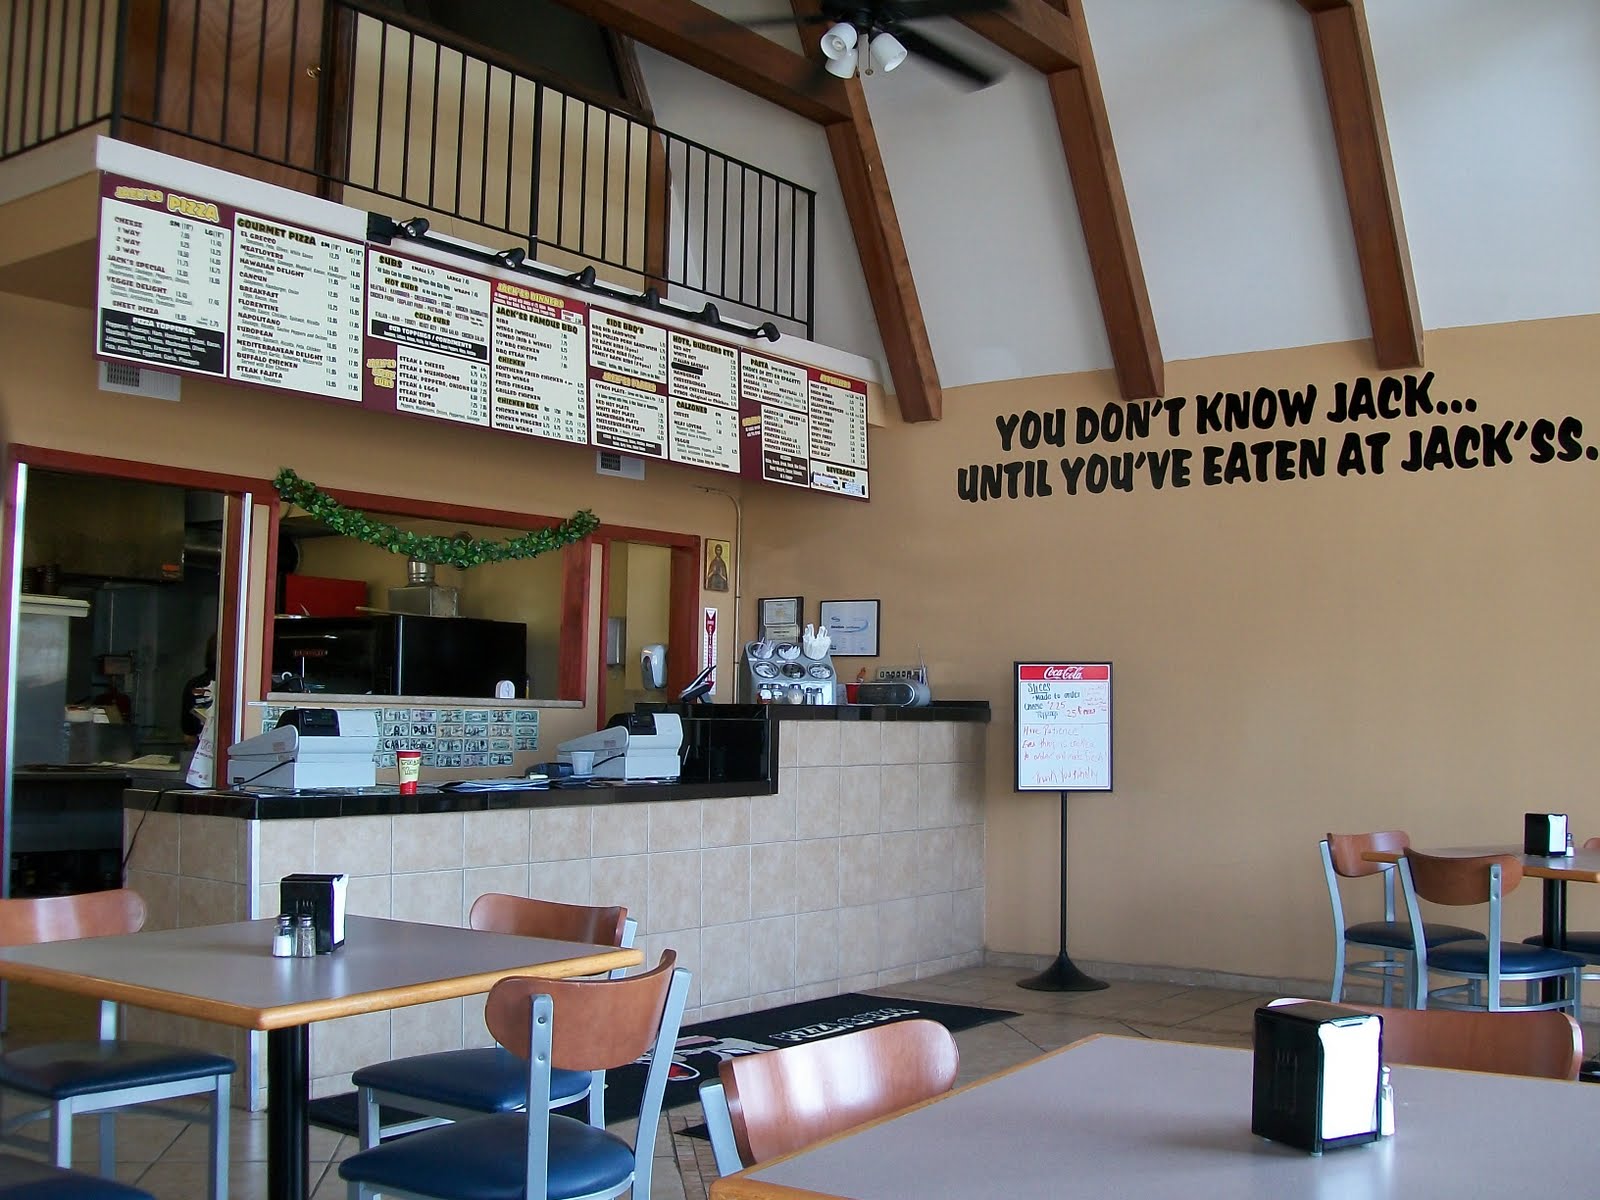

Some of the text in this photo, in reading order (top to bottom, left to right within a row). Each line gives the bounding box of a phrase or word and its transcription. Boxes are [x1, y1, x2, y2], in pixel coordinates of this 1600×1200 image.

[167, 194, 219, 224] PIZZA
[115, 217, 142, 229] CHEESE
[123, 228, 140, 237] WAY
[238, 218, 286, 239] GOURMET
[289, 231, 316, 246] PIZZA
[123, 238, 140, 247] WAY
[123, 247, 140, 256] WAY
[241, 245, 283, 260] MEATLOVERS
[107, 254, 165, 273] JACK'S SPECIAL
[380, 256, 402, 269] SUBS
[240, 272, 267, 283] CANCUN
[277, 267, 304, 278] DELIGHT
[107, 275, 167, 295] VEGGIE DELIGHT
[385, 278, 418, 292] HOT SUBS
[240, 285, 278, 299] BREAKFAST
[138, 305, 159, 315] PIZZA
[239, 299, 279, 312] FLORENTINE
[133, 317, 154, 328] PIZZA
[238, 312, 281, 326] NAPOLITANO
[415, 312, 450, 326] COLD SUBS
[530, 315, 560, 329] FAMOUS
[562, 324, 578, 334] BBQ
[607, 318, 621, 329] SIDE
[238, 326, 273, 338] EUROPEAN
[496, 332, 515, 340] COMBO
[237, 339, 323, 362] MEDITERRANEAN DELIGHT
[237, 353, 298, 369] BUFFALO CHICKEN
[400, 356, 418, 364] STEAK
[424, 362, 445, 370] CHEESE
[498, 356, 525, 367] CHICKEN
[751, 359, 768, 369] PASTA
[237, 366, 282, 379] STEAK FAJITA
[400, 364, 418, 372] STEAK
[424, 370, 460, 382] MUSHROOMS
[496, 365, 523, 375] SOUTHERN
[541, 375, 563, 384] CHICKEN
[399, 380, 417, 388] STEAK
[512, 383, 534, 392] FINGERS
[496, 388, 517, 396] GRILLED
[498, 397, 525, 408] CHICKEN
[677, 401, 707, 414] CALZONES
[496, 407, 519, 416] CHICKEN
[996, 371, 1477, 452] YOU DON'T KNOW JACK...
[496, 414, 542, 427] CHICKEN FINGERS
[957, 416, 1599, 502] UNTIL YOU'VE EATEN AT JACK'SS.
